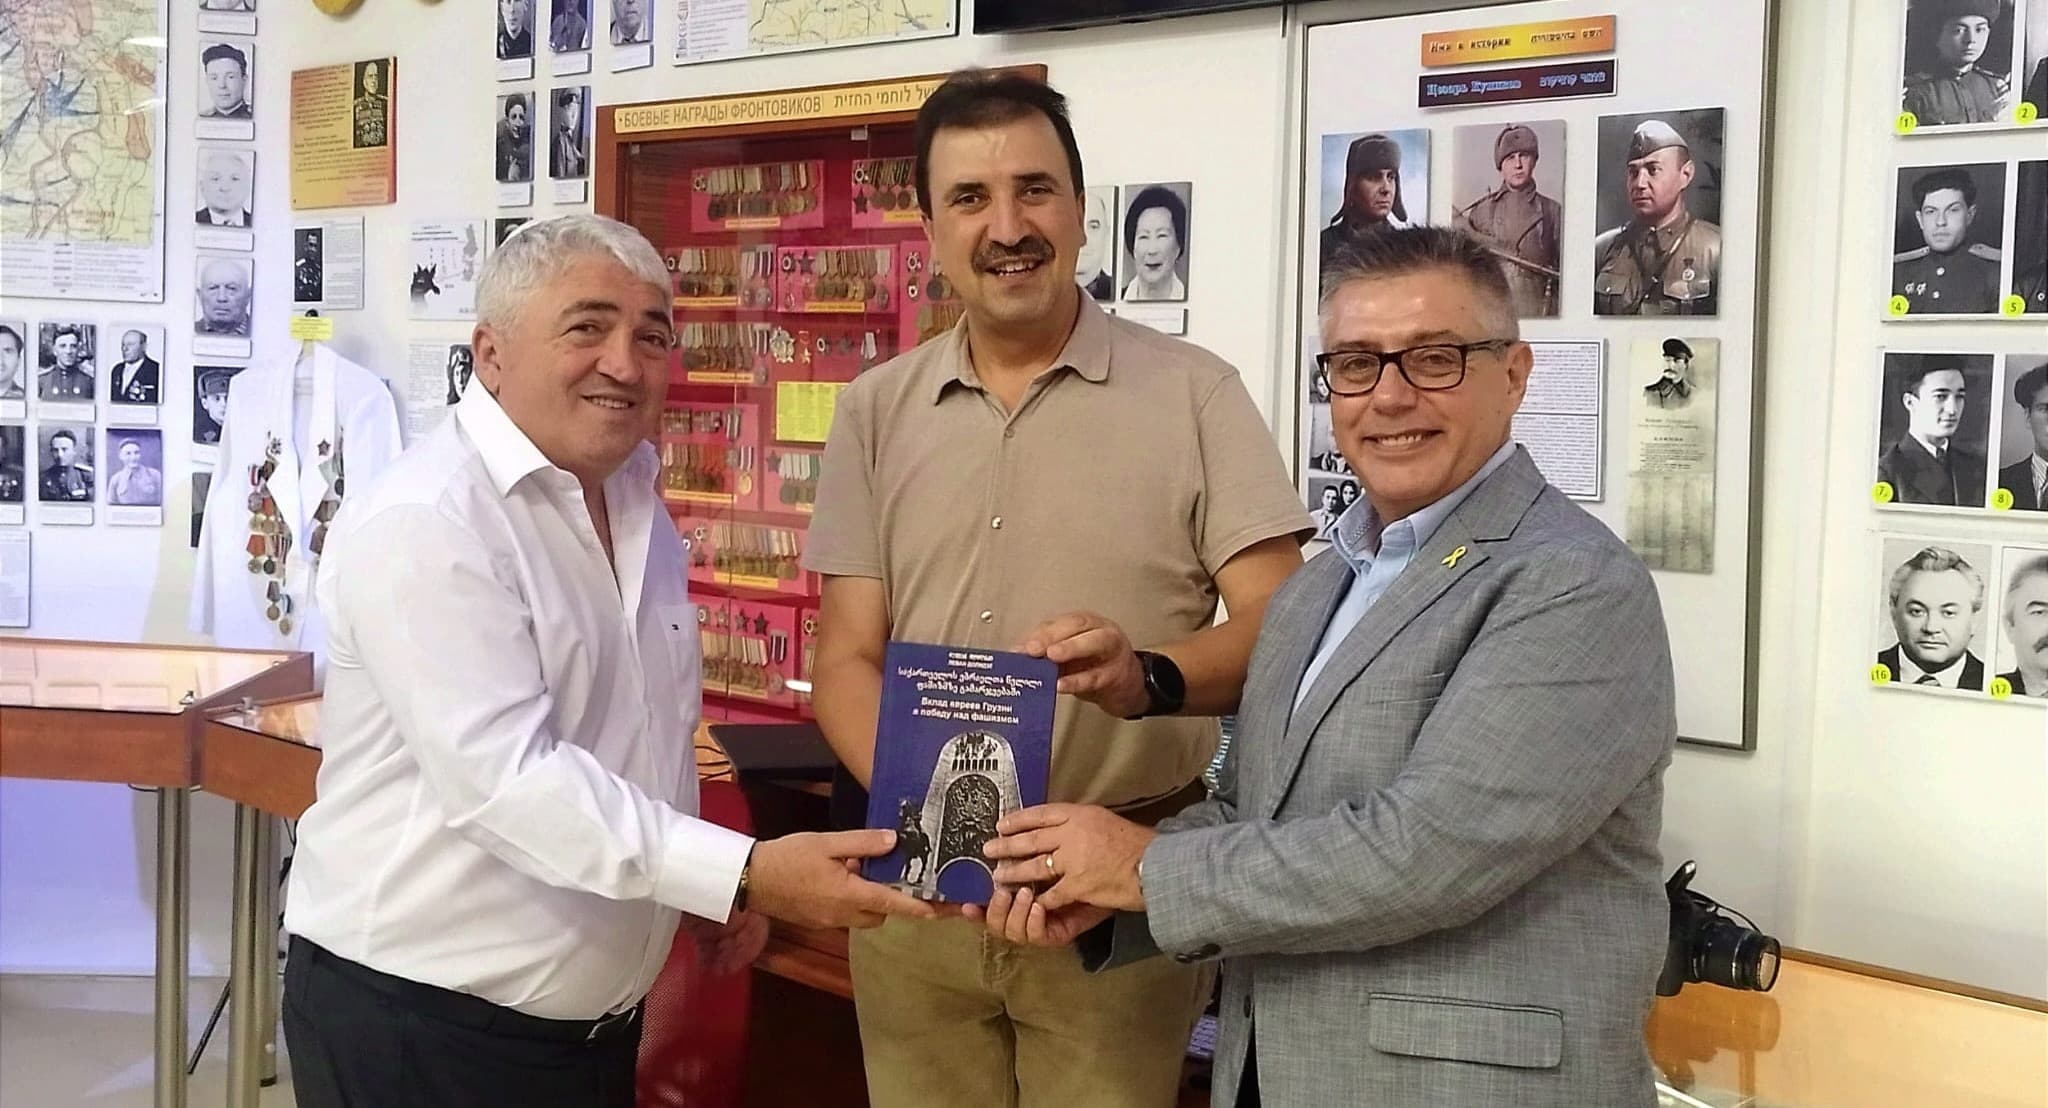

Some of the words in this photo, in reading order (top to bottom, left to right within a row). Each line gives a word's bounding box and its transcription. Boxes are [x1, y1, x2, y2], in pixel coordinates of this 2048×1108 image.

[1470, 38, 1511, 51] истории
[833, 92, 873, 108] החזית
[876, 85, 911, 105] לוחמי
[623, 110, 670, 129] БОЕВЫЕ
[673, 106, 729, 124] НАГРАДЫ
[730, 101, 821, 120] ФРОНТОВИКОВ
[922, 697, 948, 708] Вклад
[983, 702, 1013, 713] Грузии
[920, 708, 951, 720] победу
[953, 711, 970, 721] над
[971, 712, 1019, 724] фашизмом
